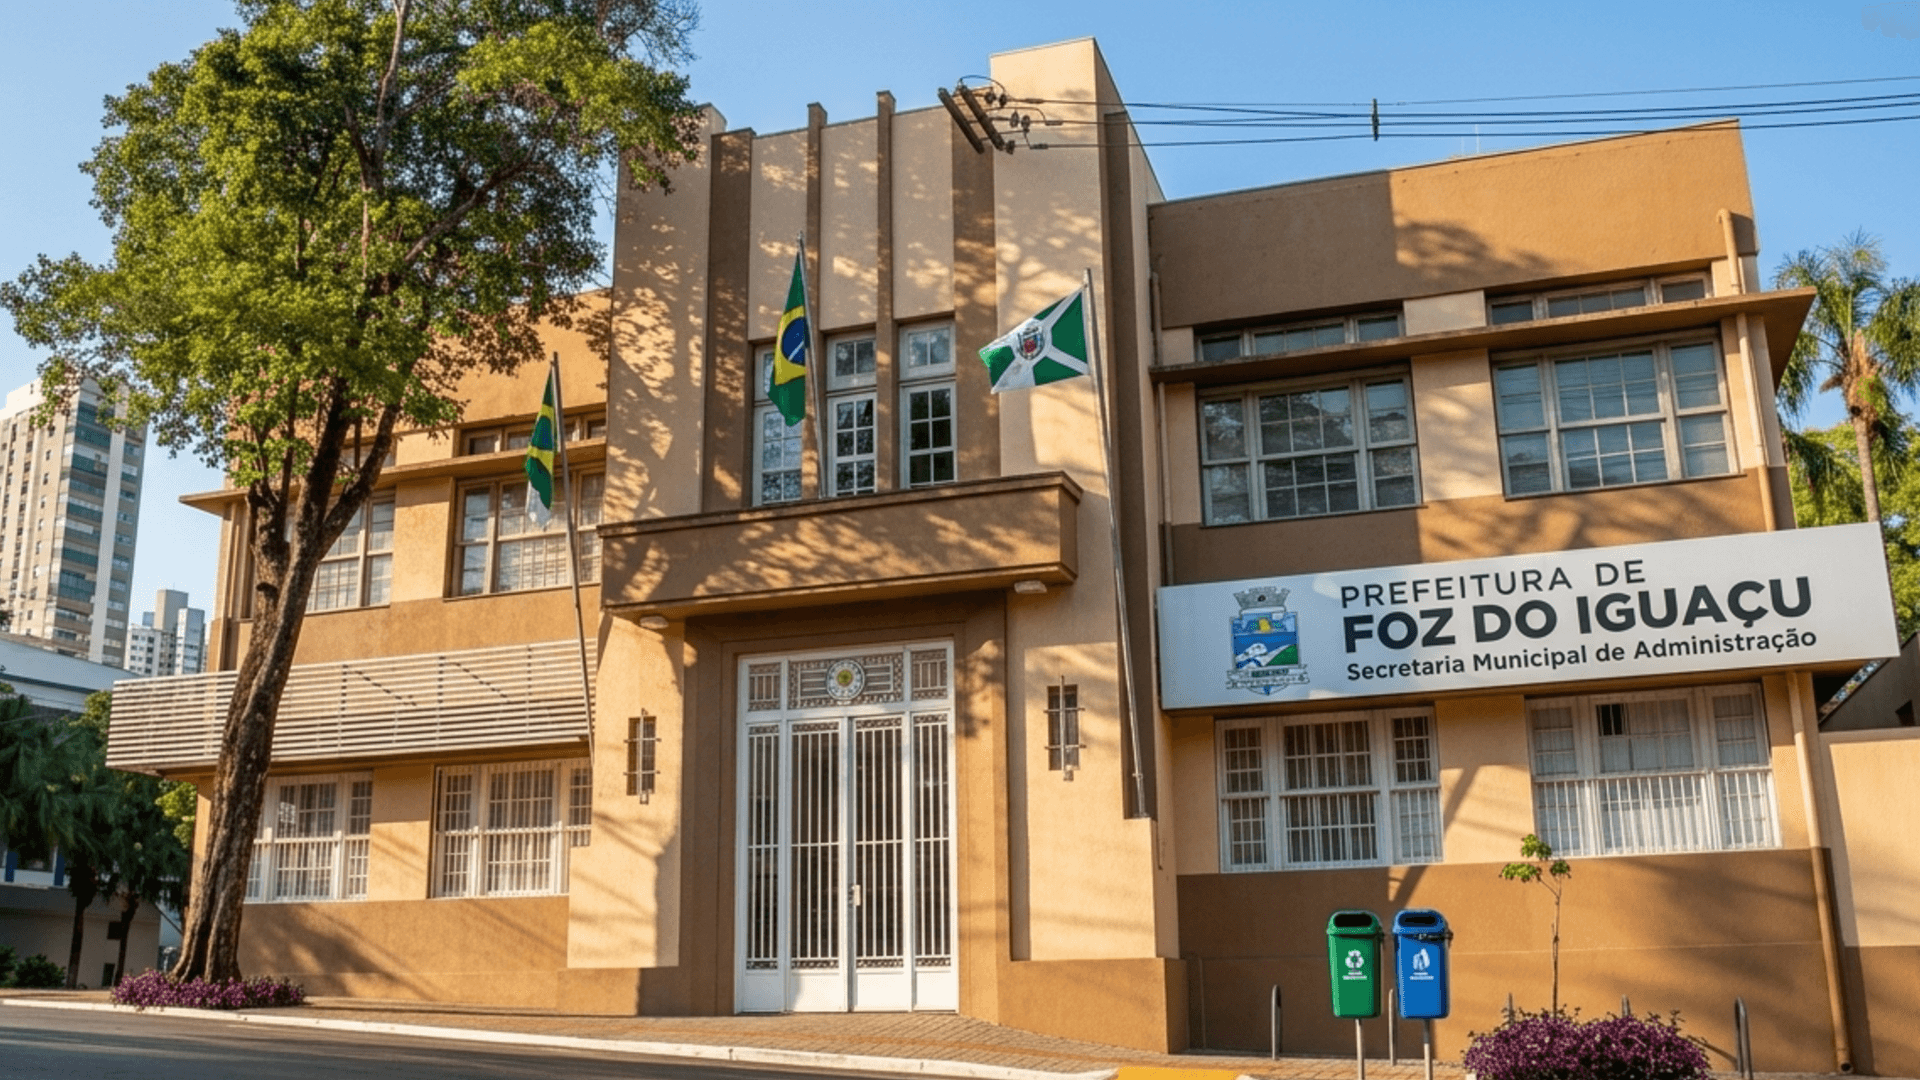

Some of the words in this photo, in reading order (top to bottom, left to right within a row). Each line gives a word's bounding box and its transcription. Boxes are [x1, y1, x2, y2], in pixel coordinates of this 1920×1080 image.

[1341, 568, 1573, 609] PREFEITURA
[1595, 560, 1646, 587] DE
[1342, 607, 1456, 654] FOZ
[1472, 599, 1558, 643] DO
[1576, 576, 1812, 635] IGUAÇU
[1346, 656, 1466, 682] Secretaria
[1472, 644, 1587, 672] Municipal
[1595, 642, 1625, 661] de
[1633, 627, 1817, 660] Administração
